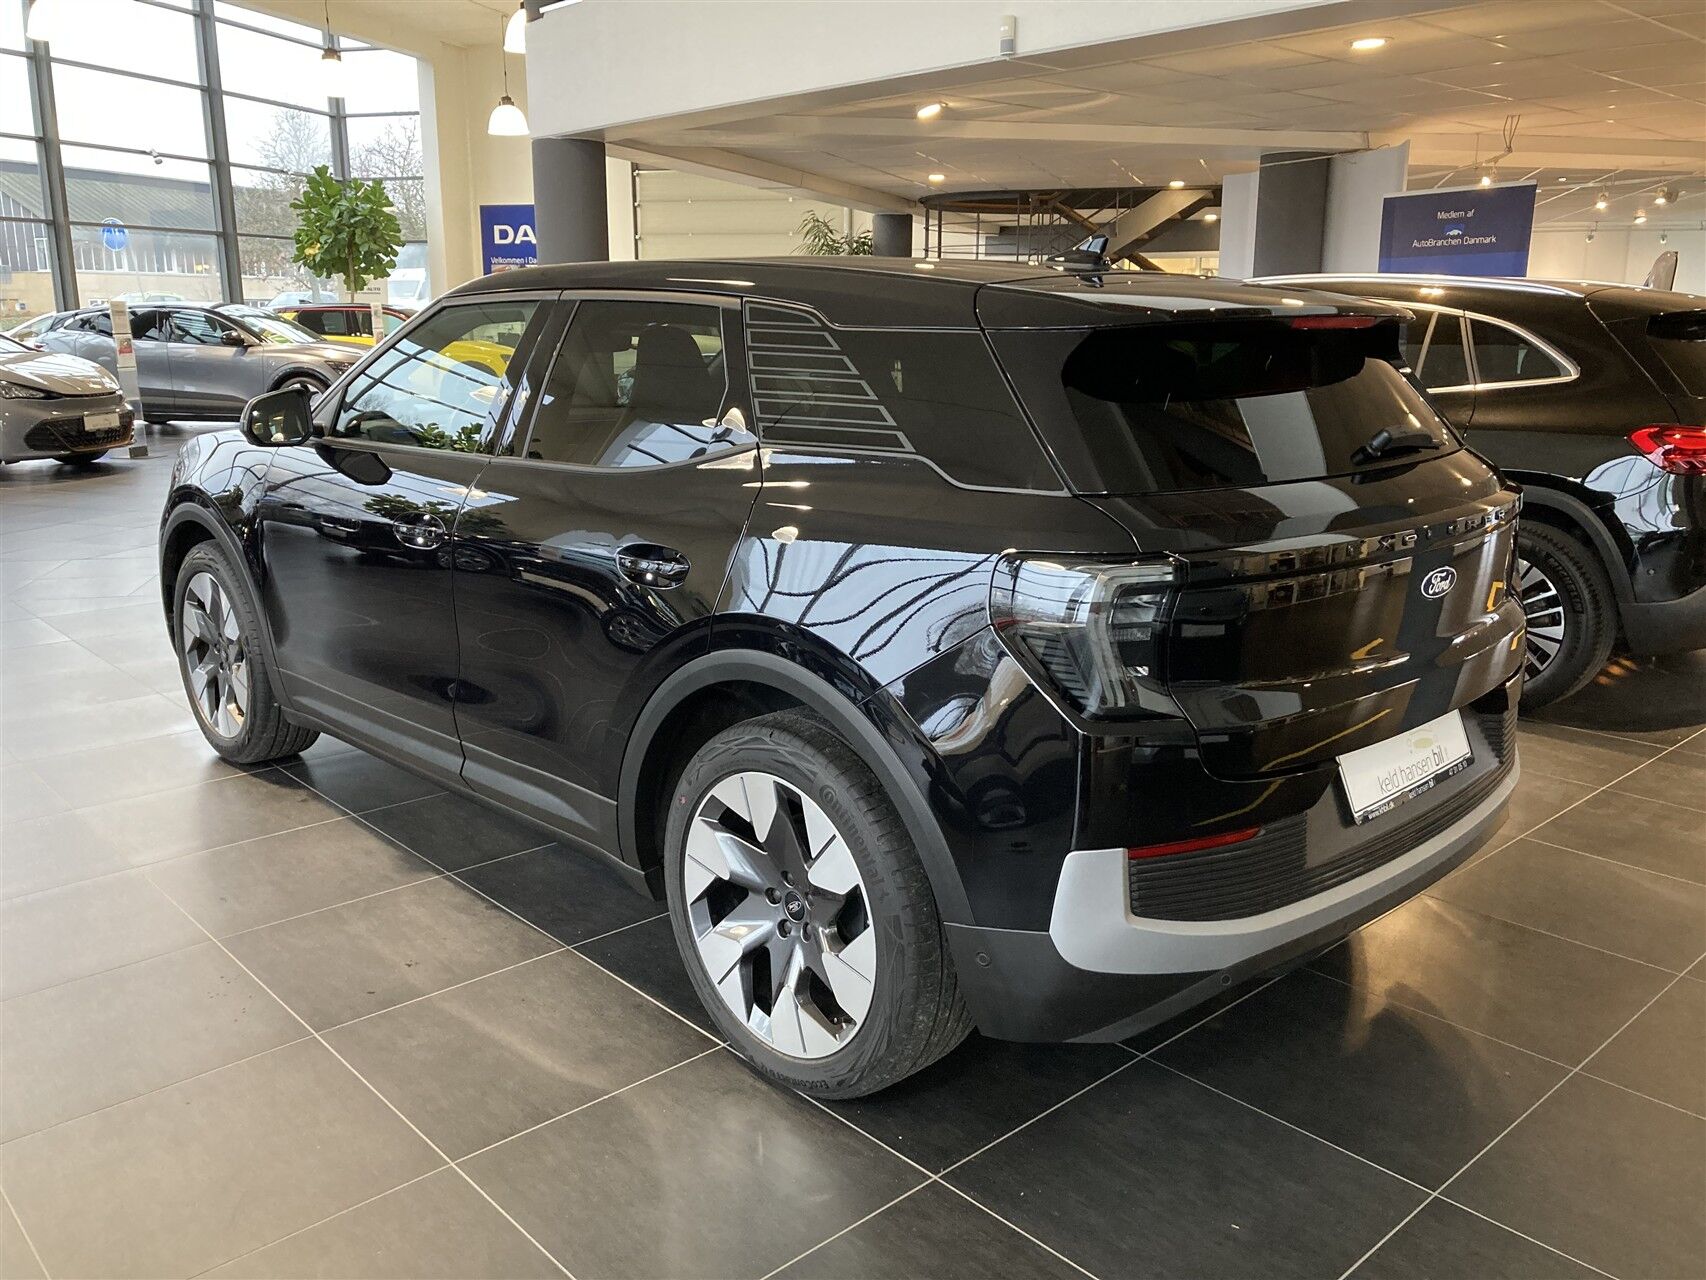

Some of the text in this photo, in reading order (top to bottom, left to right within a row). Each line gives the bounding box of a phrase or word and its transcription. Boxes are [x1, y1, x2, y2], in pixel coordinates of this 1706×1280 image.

[1437, 209, 1475, 220] Medlem af
[493, 224, 537, 244] DA
[1412, 235, 1497, 248] AutoBranchen Danmark
[490, 256, 525, 264] Velkommen
[1427, 571, 1453, 595] Ford
[1377, 768, 1400, 795] keld
[1399, 756, 1433, 784] hansen
[1431, 744, 1445, 767] bil
